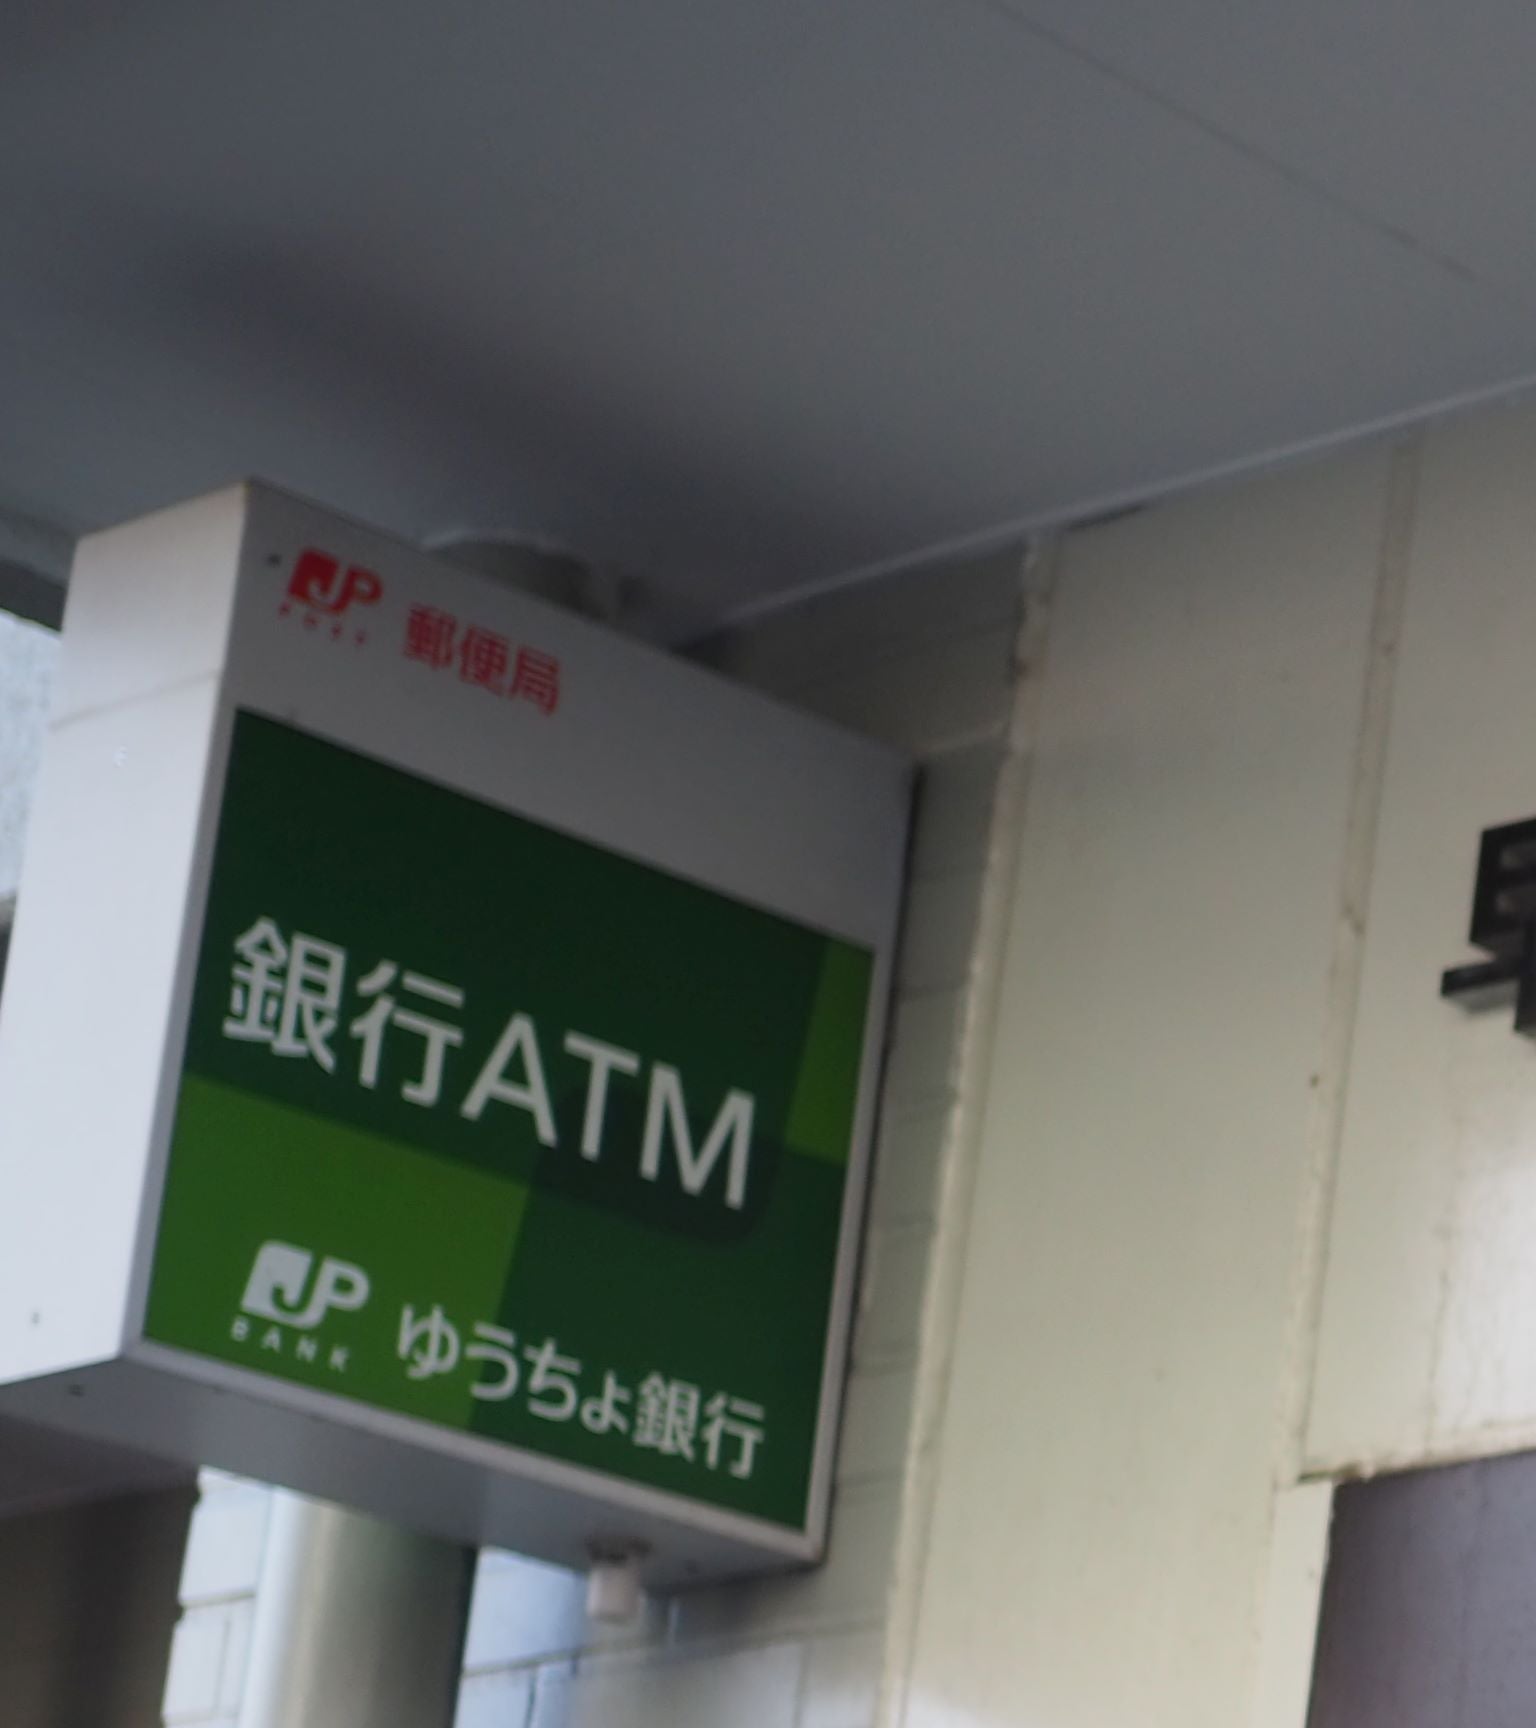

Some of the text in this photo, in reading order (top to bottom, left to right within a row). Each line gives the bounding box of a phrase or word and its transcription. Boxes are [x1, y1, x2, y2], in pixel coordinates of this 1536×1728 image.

[402, 602, 562, 717] 郵便局
[223, 916, 756, 1210] 銀行ATM
[231, 1318, 351, 1371] BANK
[397, 1302, 764, 1478] ゆうちょ銀行
